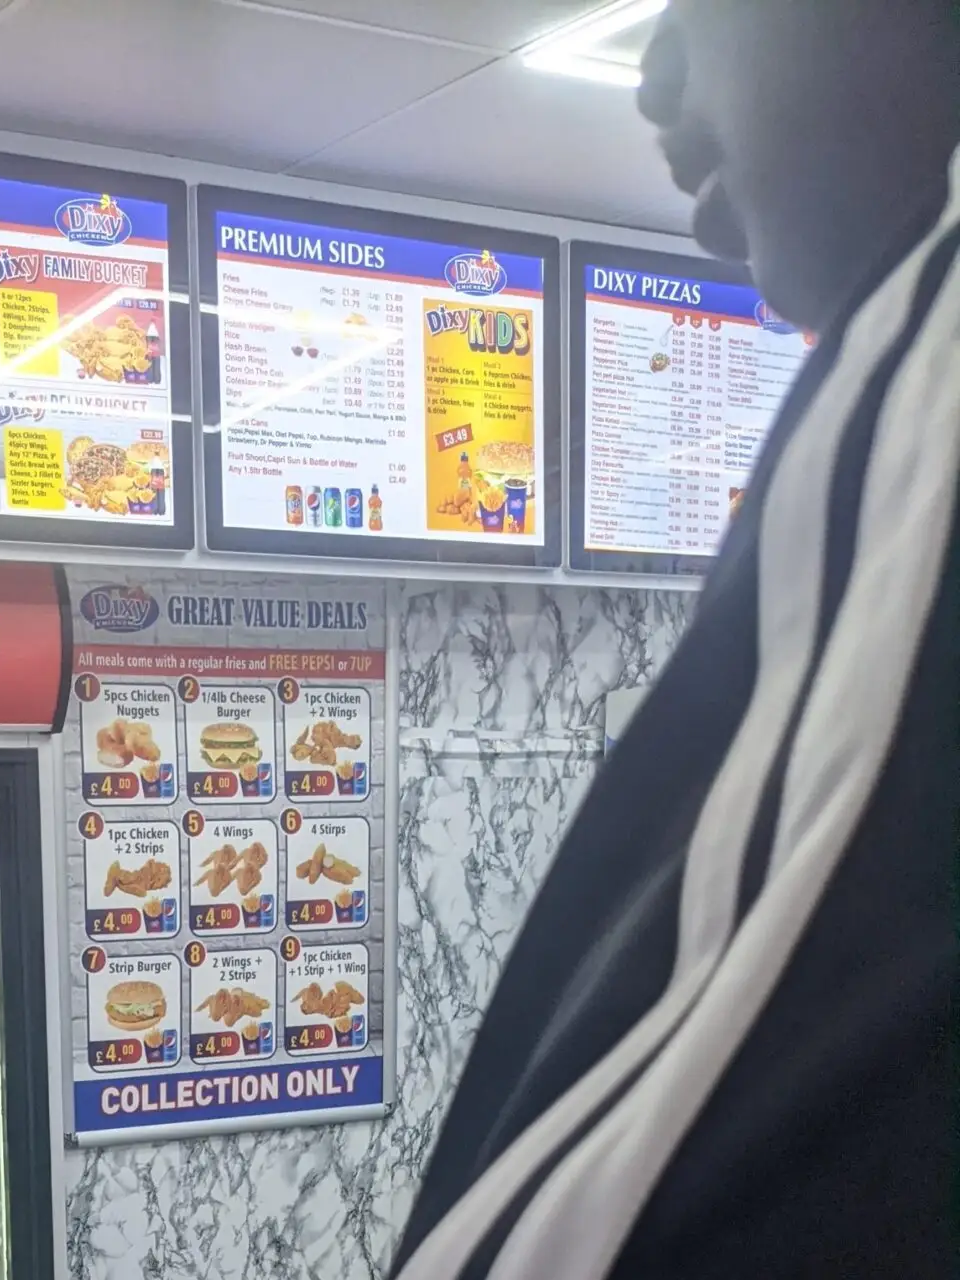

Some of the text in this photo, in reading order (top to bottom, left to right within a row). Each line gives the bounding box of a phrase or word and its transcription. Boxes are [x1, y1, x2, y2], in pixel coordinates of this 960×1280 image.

[67, 200, 122, 241] Dixy
[70, 230, 110, 244] CHICKEN
[220, 224, 385, 270] PREMIUM SIDES
[454, 256, 499, 289] Dixy
[594, 268, 701, 305] DIXY PIZZAS
[425, 301, 530, 358] Dixy KIDS
[442, 426, 467, 448] £3.49
[91, 589, 367, 630] Dixy GREAT VALUE DEALS
[78, 652, 372, 673] All meals come with a regular fries and FREE PEPSI or 7UP
[81, 677, 91, 699] 1
[104, 689, 170, 704] 5pcs Chicken
[183, 679, 194, 700] 2
[201, 691, 266, 704] 1/4lb Cheese
[283, 680, 293, 700] 3
[304, 692, 361, 705] 1pc Chicken
[116, 706, 160, 719] Nuggets
[217, 706, 252, 720] Burger
[327, 707, 358, 721] Wings
[84, 815, 97, 836] 4
[188, 813, 199, 833] 5
[286, 811, 297, 830] 6
[311, 823, 346, 837] 4 Stirps
[108, 828, 169, 842] 1pc Chicken
[213, 826, 253, 840] 4 Wings
[134, 842, 165, 856] Strips
[190, 944, 201, 964] 8
[286, 938, 296, 958] 9
[303, 950, 352, 965] 1pc Chicken
[87, 949, 98, 969] 7
[109, 960, 172, 976] Strip Burger
[212, 957, 219, 969] 2
[222, 956, 252, 969] Wings
[219, 969, 257, 983] 2 Strips
[304, 964, 325, 978] Strip
[344, 962, 366, 975] Wing
[101, 1064, 360, 1115] COLLECTION ONLY
